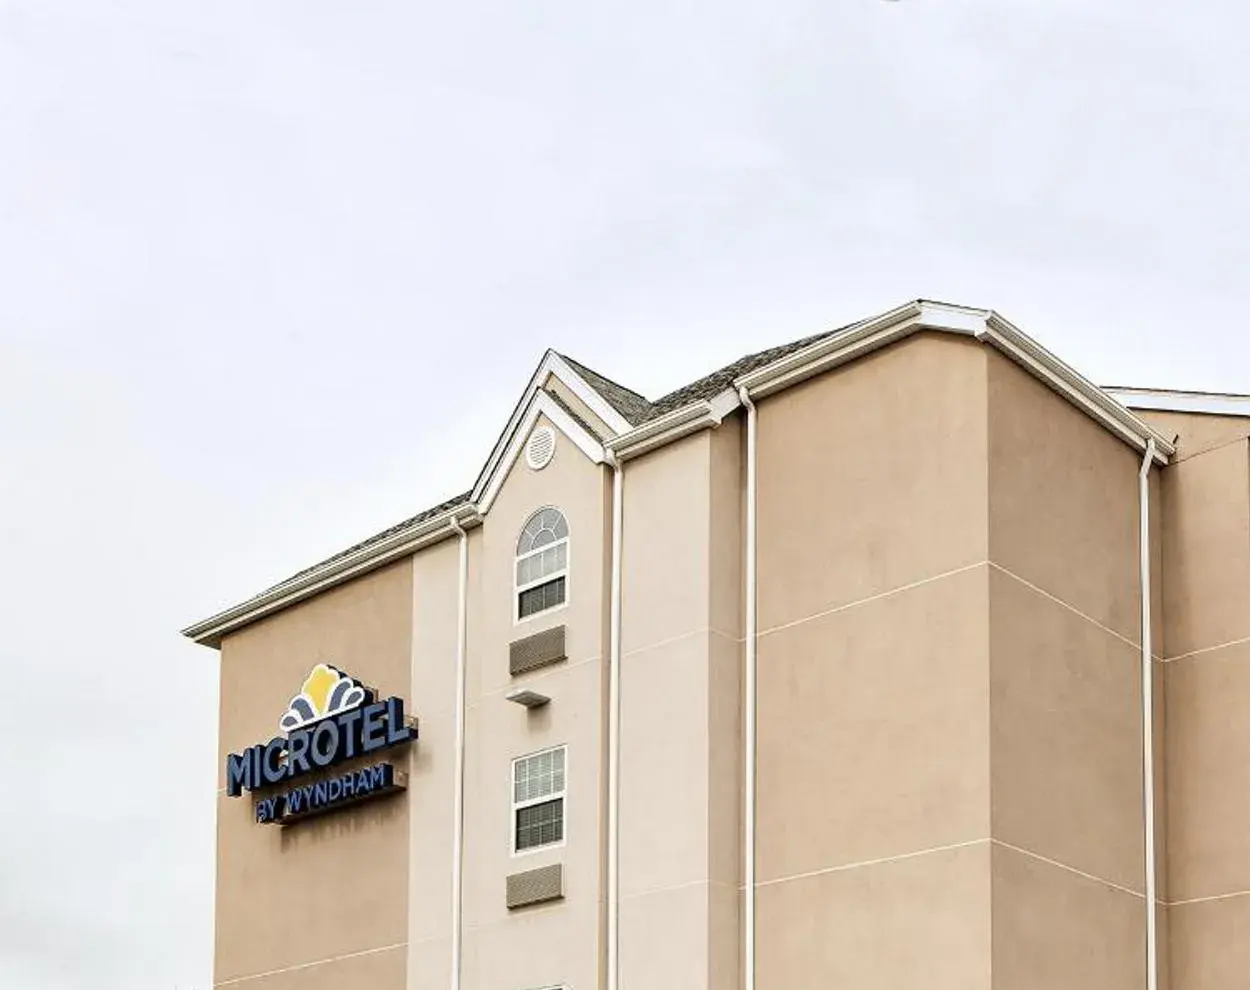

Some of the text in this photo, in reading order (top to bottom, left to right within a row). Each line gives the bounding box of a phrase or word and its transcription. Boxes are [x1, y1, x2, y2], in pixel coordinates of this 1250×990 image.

[227, 697, 411, 796] MICROTEL
[257, 765, 386, 820] BY WYNDHAM
